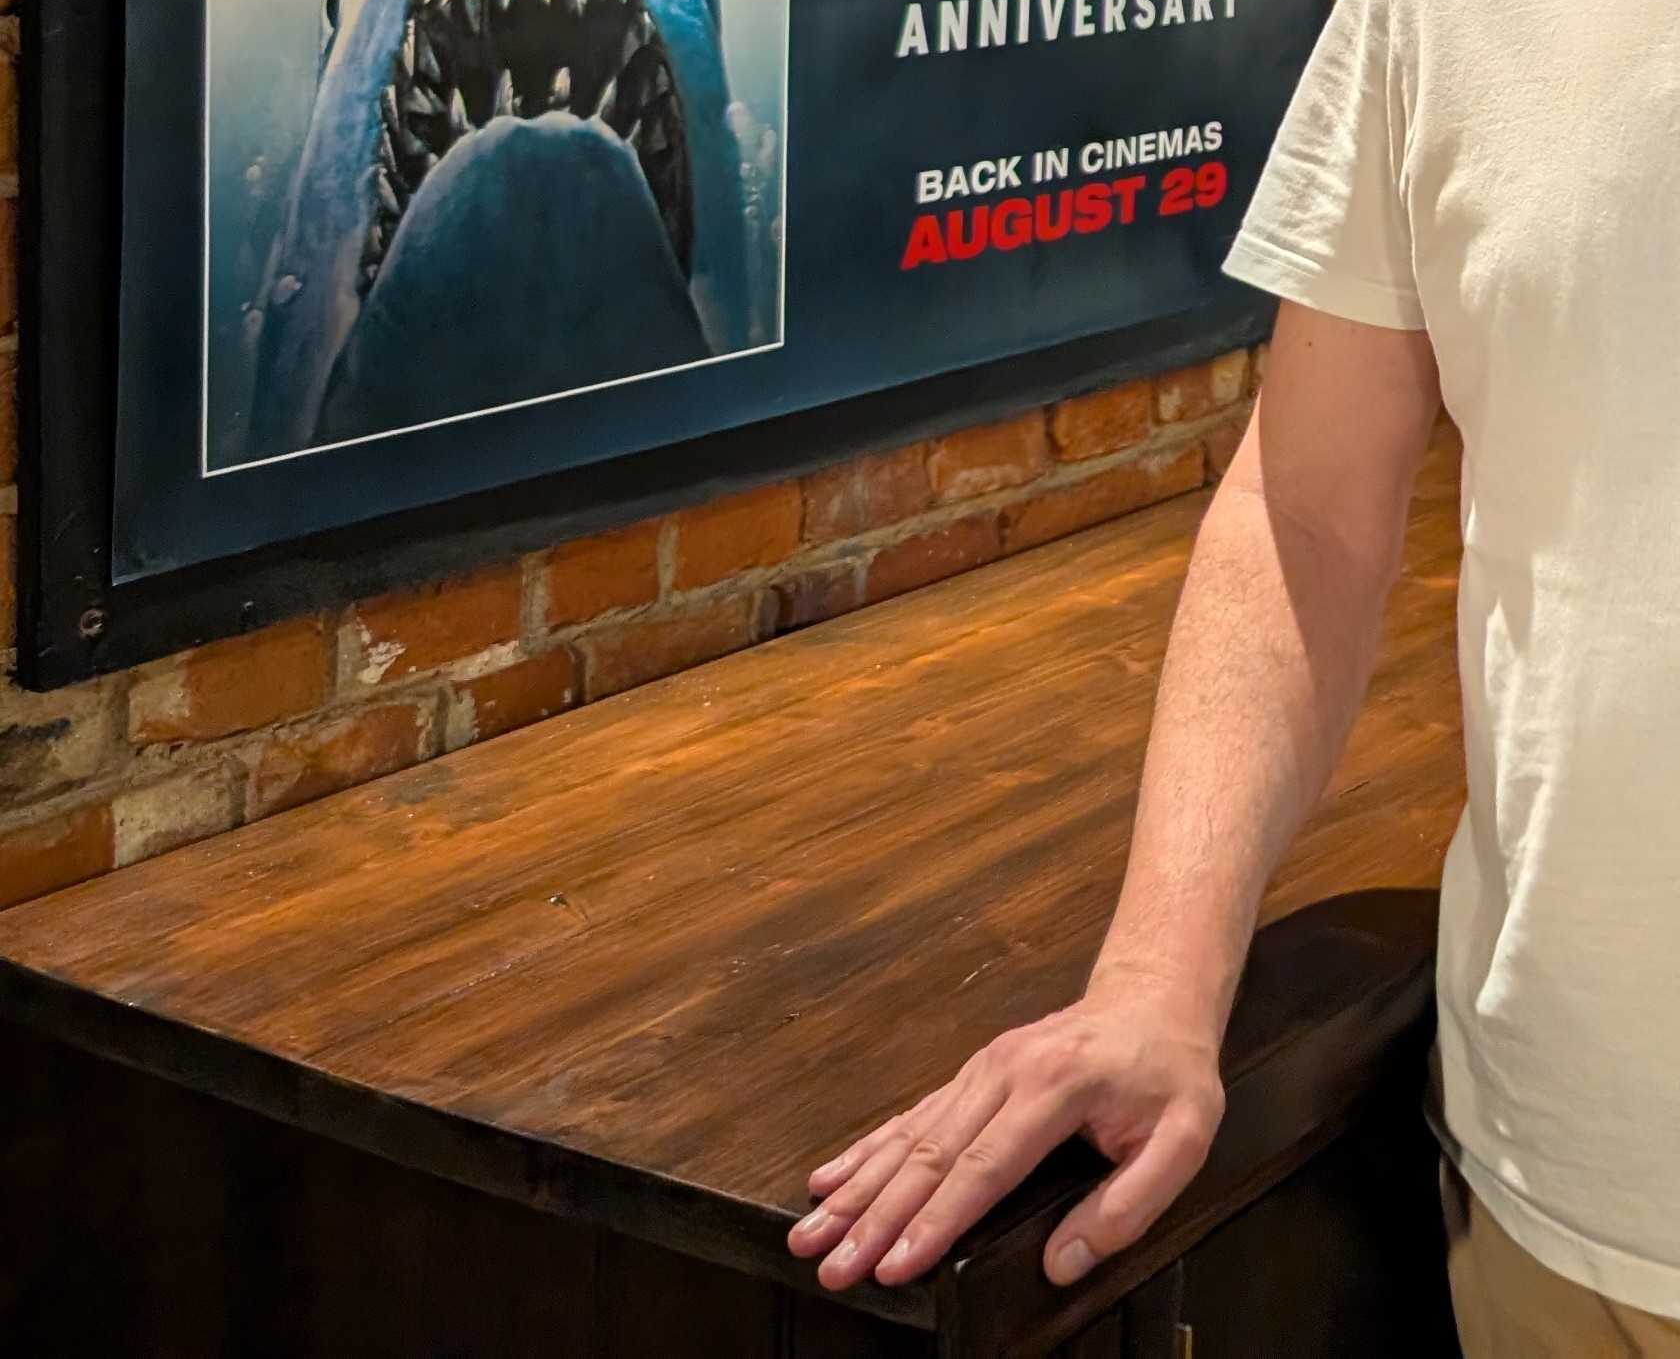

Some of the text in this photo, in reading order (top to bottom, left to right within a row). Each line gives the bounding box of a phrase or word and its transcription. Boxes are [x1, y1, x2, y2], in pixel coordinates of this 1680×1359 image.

[916, 121, 1224, 204] BACK IN CINEMAS
[901, 161, 1228, 270] AUGUST 29
